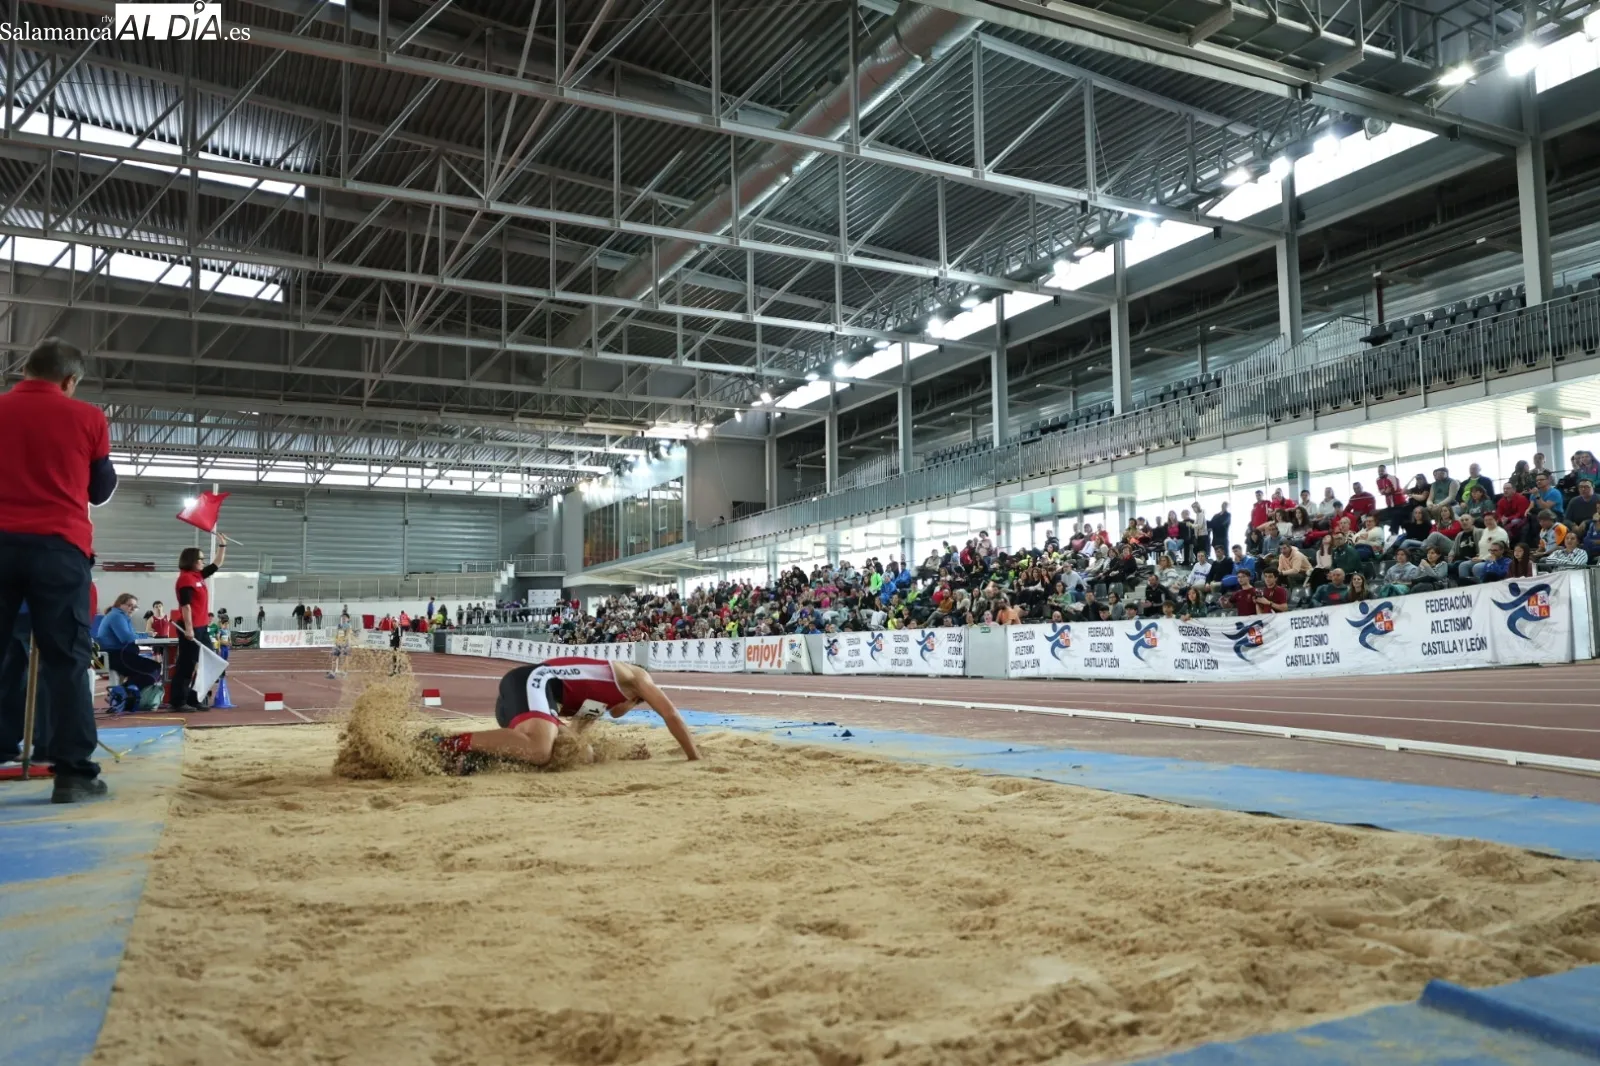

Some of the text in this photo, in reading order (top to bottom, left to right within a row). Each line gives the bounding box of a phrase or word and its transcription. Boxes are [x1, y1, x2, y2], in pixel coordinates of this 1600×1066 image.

[1425, 591, 1472, 613] FEDERACIÓN
[1290, 611, 1329, 630] FEDERACIÓN
[1431, 616, 1473, 634] ATLETISMO
[1088, 624, 1114, 637] FEDERACIÓN
[1090, 642, 1113, 653] ATLETISMO
[1181, 642, 1210, 653] ATLETISMO
[1294, 633, 1329, 648] ATLETISMO
[1421, 633, 1487, 656] CASTILLA Y LEÓN
[747, 637, 783, 668] enjoy!
[1285, 648, 1340, 667] CASTILLA Y LEÓN
[1174, 658, 1199, 670] CASTILLA
